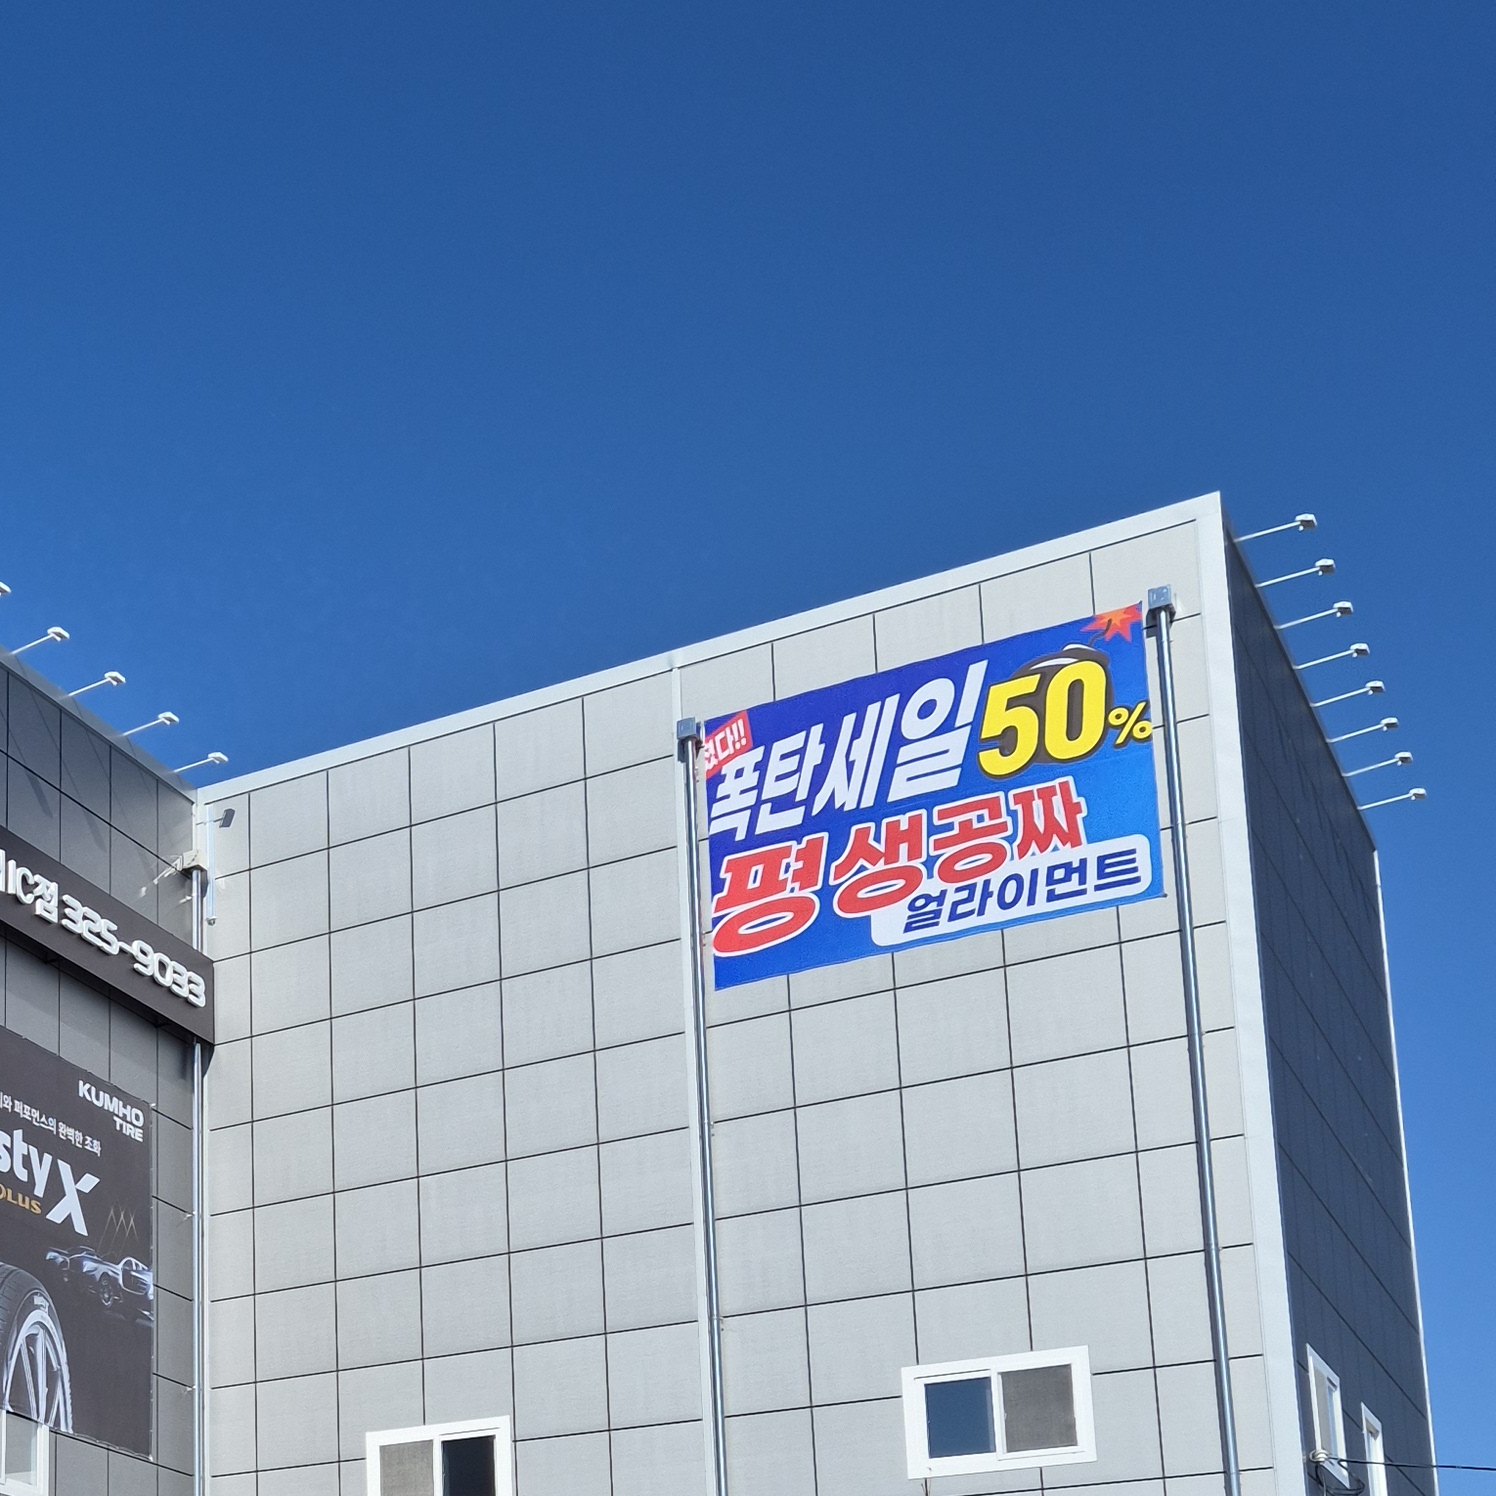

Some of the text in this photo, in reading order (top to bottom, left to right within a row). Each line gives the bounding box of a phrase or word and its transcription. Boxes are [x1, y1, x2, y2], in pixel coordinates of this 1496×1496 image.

[709, 659, 1153, 842] 폭탄세일 50%
[712, 780, 1085, 955] 평생공짜
[902, 847, 1142, 934] 얼라이먼트
[61, 894, 206, 1008] 325-9033
[13, 1099, 57, 1135] 퍼포먼스의
[58, 1121, 83, 1148] 완벽한
[84, 1135, 102, 1157] 조화
[78, 1079, 144, 1128] KUMHO
[112, 1115, 144, 1142] TIRE
